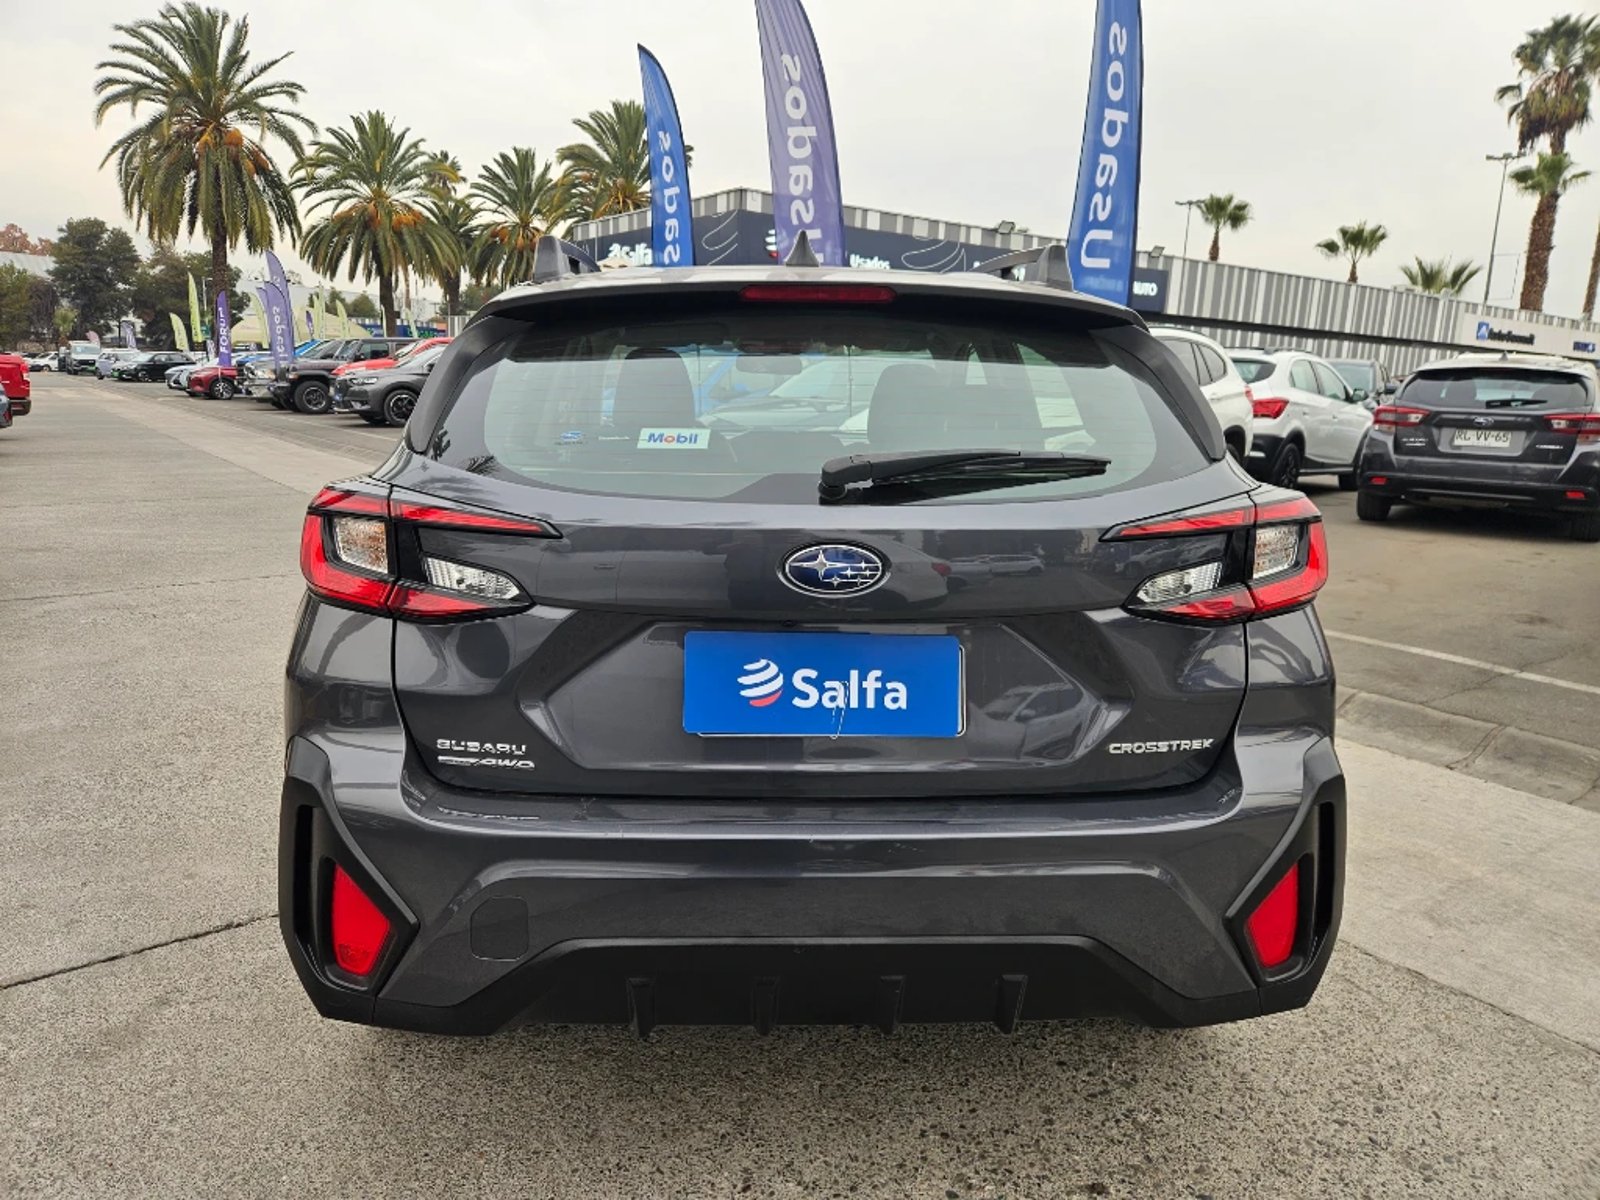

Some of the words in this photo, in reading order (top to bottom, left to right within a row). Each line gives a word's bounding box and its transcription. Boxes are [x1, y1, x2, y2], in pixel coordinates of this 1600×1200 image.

[850, 253, 890, 269] Usados
[647, 432, 698, 444] Mobil
[791, 667, 908, 710] Salfa
[436, 738, 527, 755] SUBARU
[1108, 738, 1214, 754] CROSSTREK
